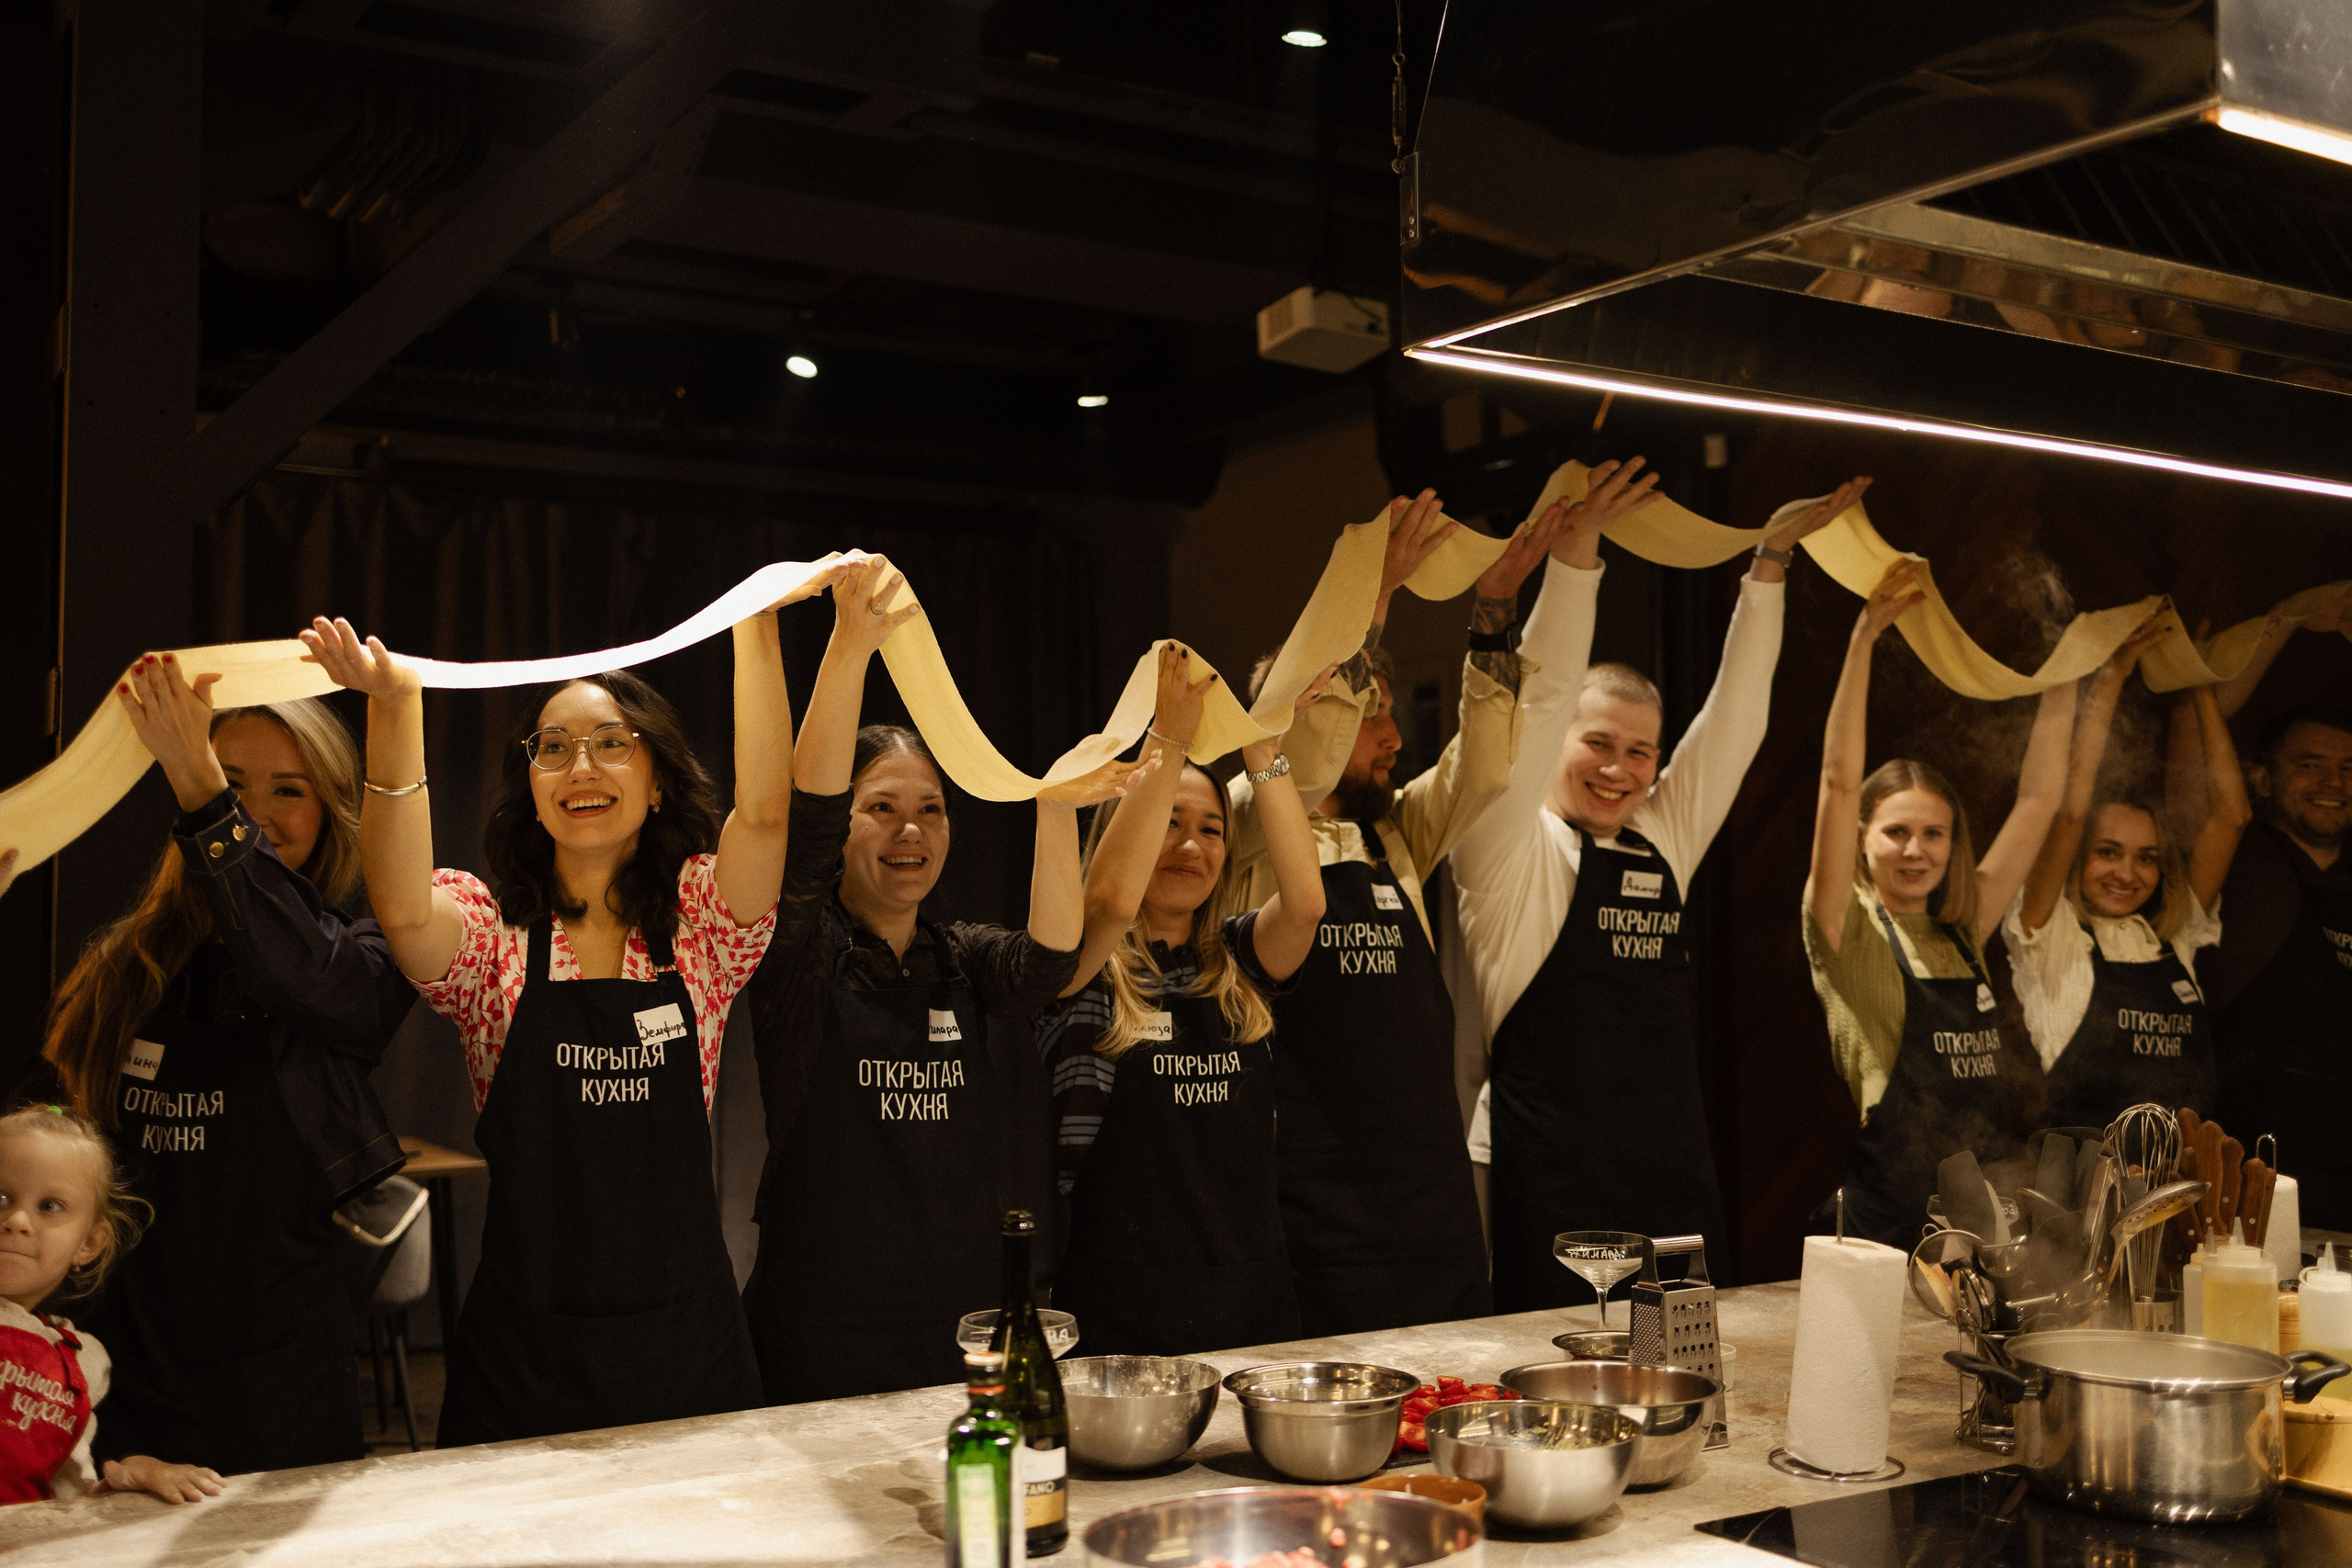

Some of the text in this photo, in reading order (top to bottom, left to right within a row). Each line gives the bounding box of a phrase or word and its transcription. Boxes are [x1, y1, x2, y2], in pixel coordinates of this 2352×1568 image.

[1598, 907, 1680, 934] ОТКРЫТАЯ
[1320, 922, 1404, 948] ОТКРЫТАЯ
[1612, 934, 1663, 959] КУХНЯ
[1340, 950, 1397, 975] КУХНЯ
[2117, 1008, 2193, 1034] ОТКРЫТАЯ
[1933, 1028, 2001, 1055] ОТКРЫТАЯ
[2132, 1032, 2182, 1057] КУХНЯ
[556, 1043, 665, 1071] ОТКРЫТАЯ
[1153, 1051, 1241, 1076] ОТКРЫТАЯ
[1951, 1054, 1996, 1078] КУХНЯ
[858, 1059, 965, 1089] ОТКРЫТАЯ
[582, 1077, 650, 1106] КУХНЯ
[1174, 1080, 1228, 1106] КУХНЯ
[880, 1092, 949, 1121] КУХНЯ
[141, 1123, 205, 1154] КУХНЯ
[0, 1359, 75, 1408] рытая
[11, 1392, 78, 1436] кухня
